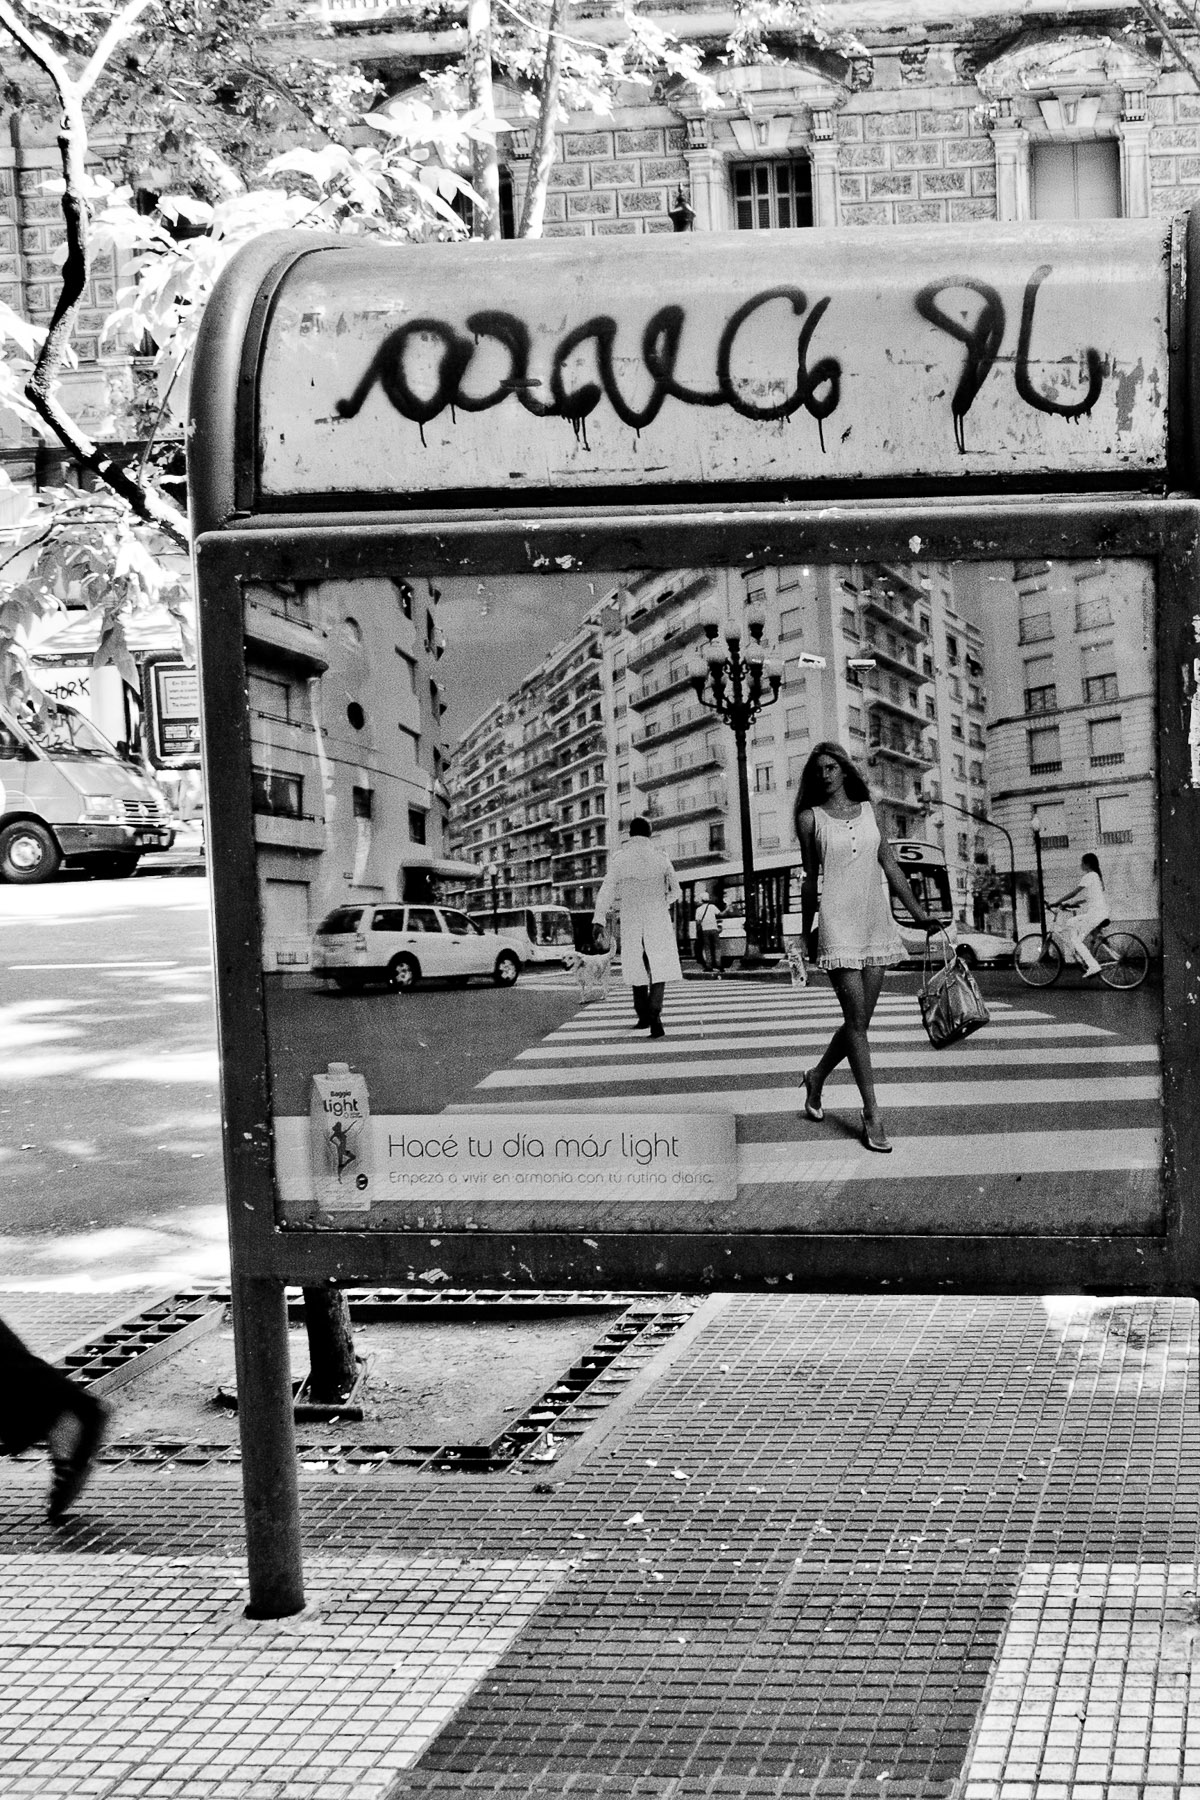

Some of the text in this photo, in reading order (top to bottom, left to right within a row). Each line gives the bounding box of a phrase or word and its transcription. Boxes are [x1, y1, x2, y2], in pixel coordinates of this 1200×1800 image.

[899, 845, 924, 861] 5
[323, 1098, 358, 1117] light
[388, 1132, 680, 1166] Hacé tu día más light
[448, 1173, 458, 1184] a
[463, 1173, 488, 1184] vivir
[493, 1173, 511, 1184] en
[577, 1173, 604, 1184] con
[627, 1172, 668, 1184] rutina
